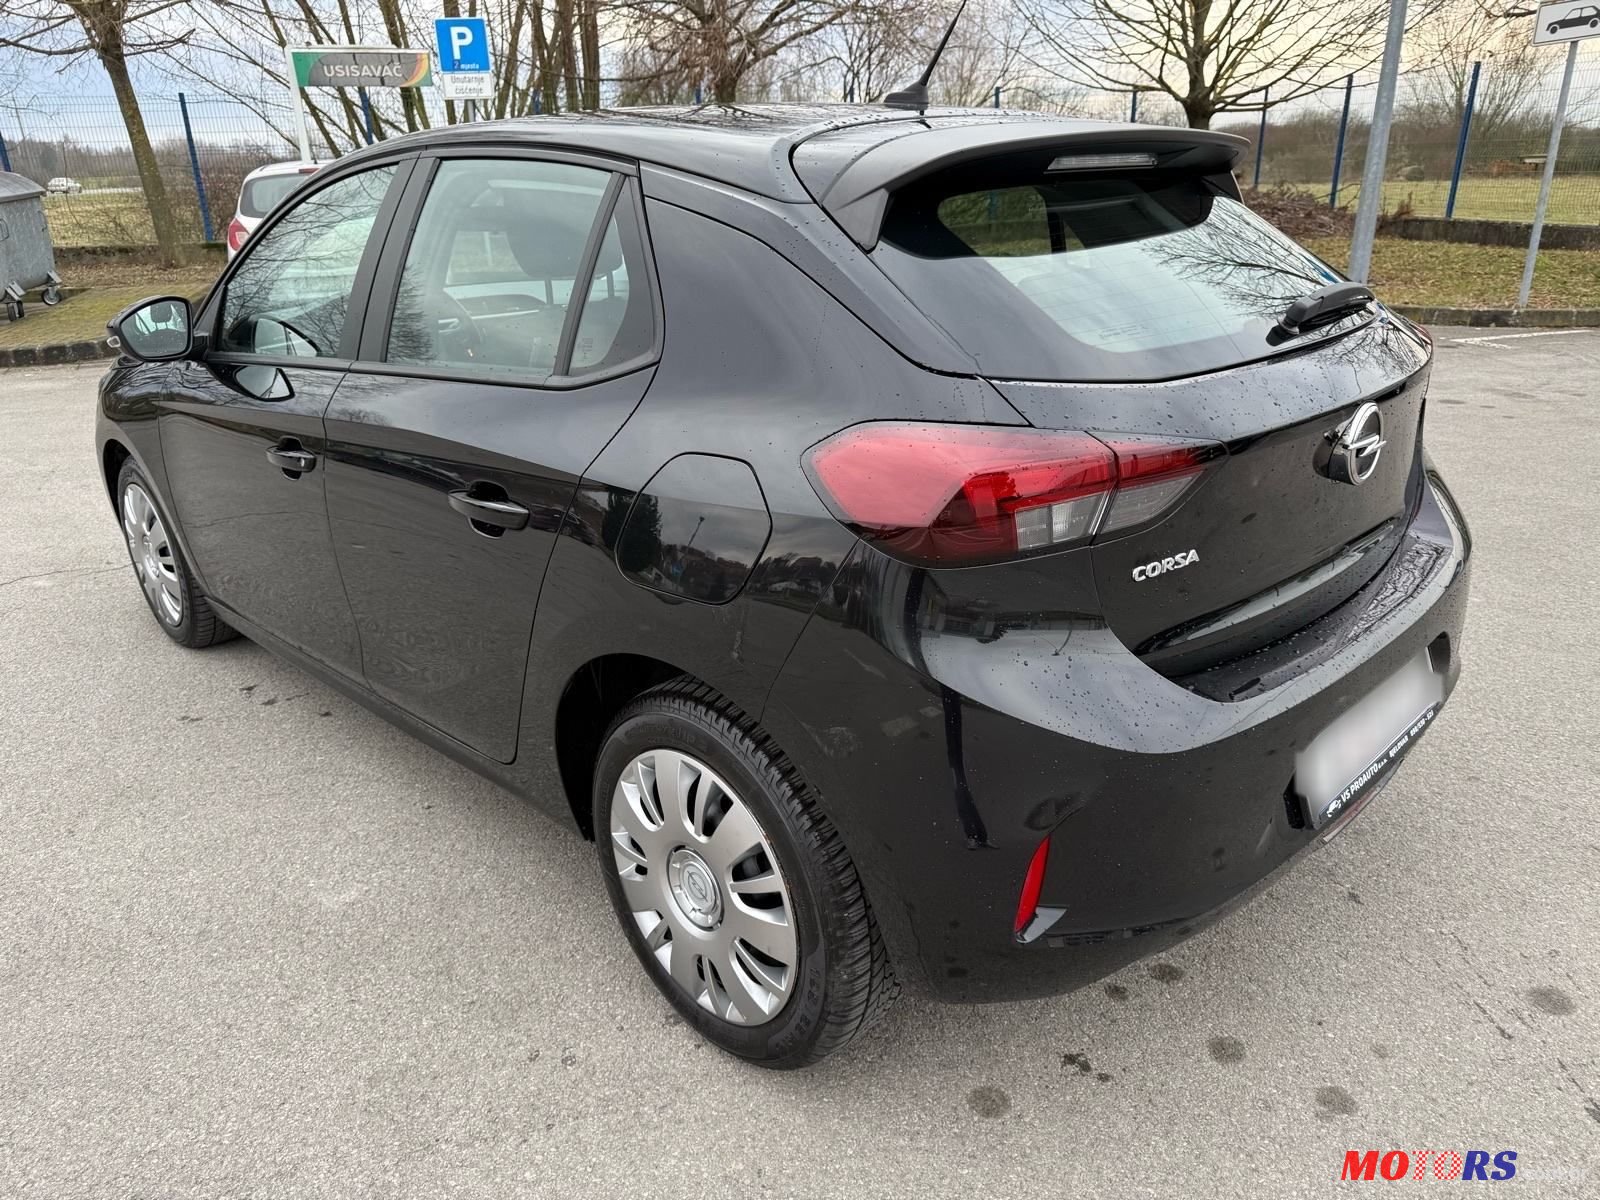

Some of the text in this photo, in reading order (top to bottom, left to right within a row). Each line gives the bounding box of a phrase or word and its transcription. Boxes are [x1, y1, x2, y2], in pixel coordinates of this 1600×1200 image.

[450, 26, 473, 60] P
[323, 63, 403, 78] USISAVAČ
[1132, 548, 1200, 582] CORSA
[1340, 789, 1351, 803] VS
[1350, 763, 1378, 795] PROAUTO
